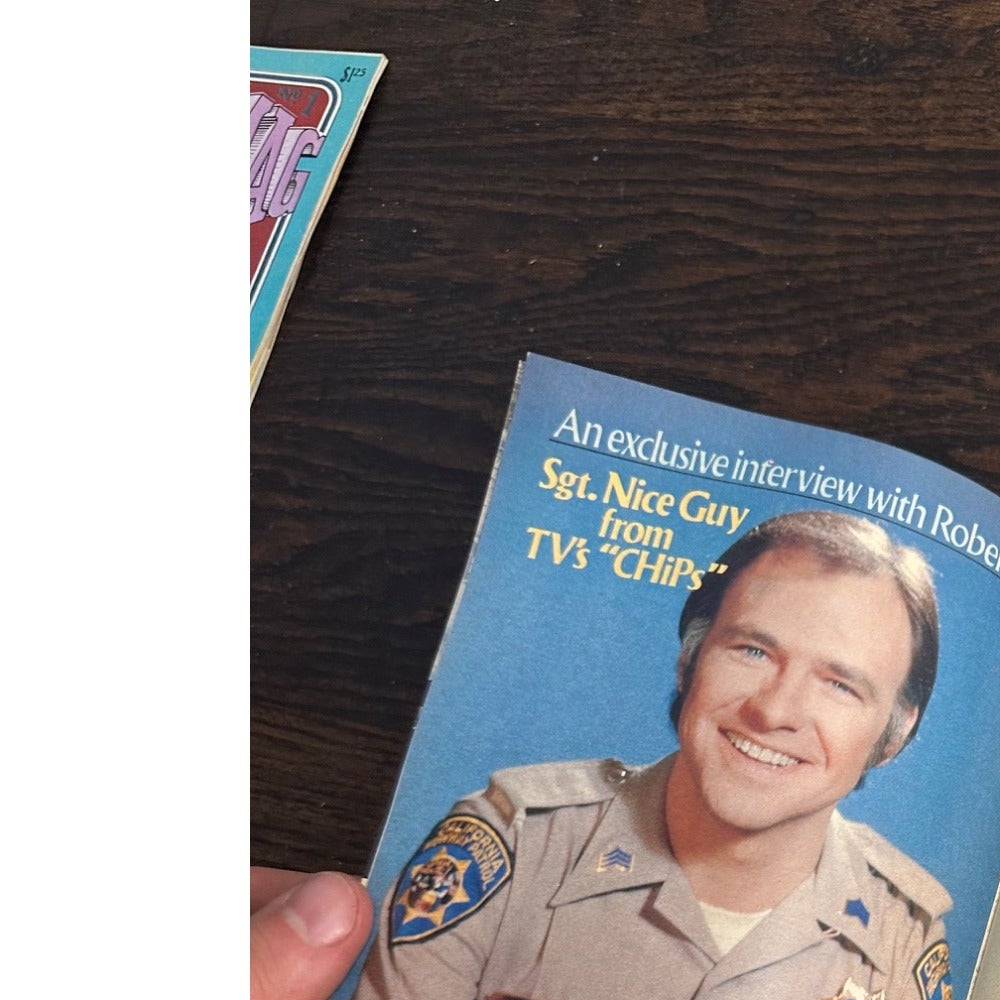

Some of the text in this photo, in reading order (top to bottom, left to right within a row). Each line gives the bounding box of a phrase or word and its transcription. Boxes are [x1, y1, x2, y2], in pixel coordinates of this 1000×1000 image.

[250, 92, 327, 223] AG
[539, 457, 750, 534] Sgt. Nice Guy
[553, 408, 602, 448] An
[607, 428, 729, 478] exclusive
[731, 450, 863, 504] interview
[867, 486, 927, 528] with
[527, 526, 592, 570] TV's
[598, 508, 674, 550] from
